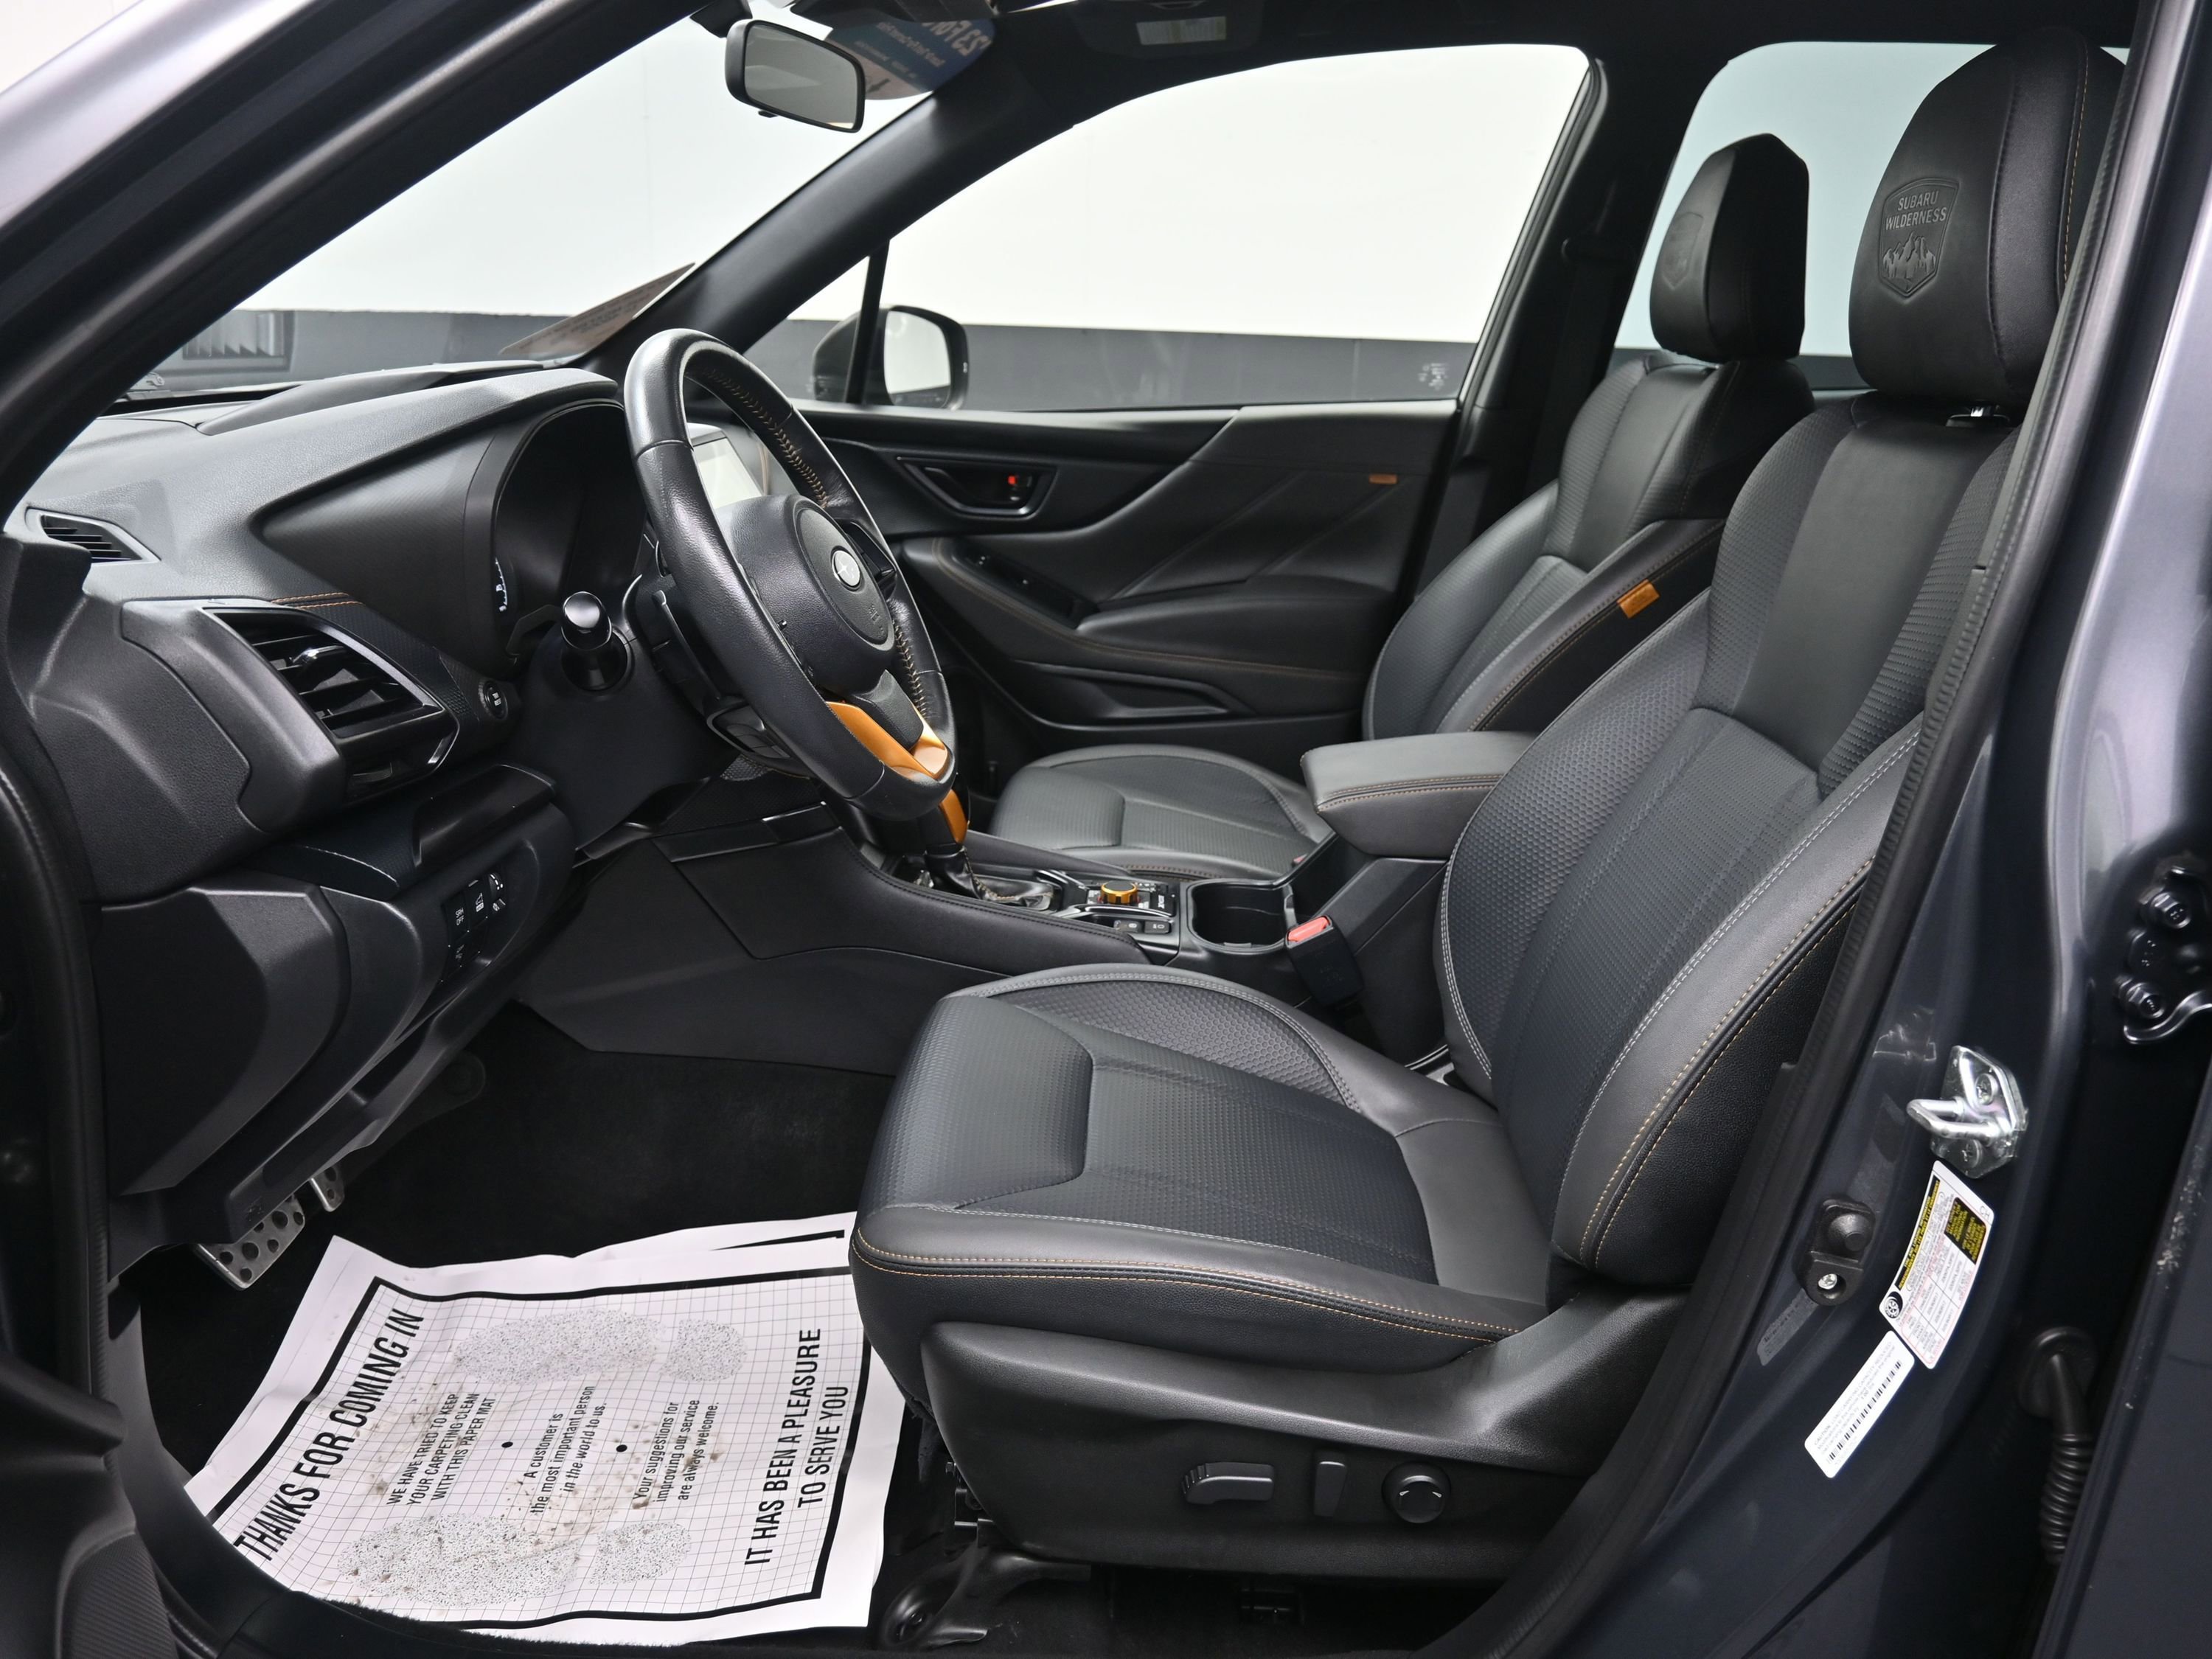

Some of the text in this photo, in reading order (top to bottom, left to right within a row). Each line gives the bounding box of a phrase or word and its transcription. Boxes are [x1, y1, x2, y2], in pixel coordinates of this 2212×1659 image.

[1885, 206, 1947, 230] WILDERNESS
[1898, 190, 1939, 211] SUBARU
[233, 1308, 424, 1561] THANKS FOR COMING IN
[386, 1394, 459, 1505] WE HAVE TRIED TO KEEP
[406, 1394, 480, 1505] YOUR CARPETING CLEAN
[431, 1398, 496, 1501] WITH THIS PAPER MAT
[524, 1413, 563, 1478] A customer is
[529, 1385, 596, 1513] the most important person
[560, 1402, 607, 1492] in the world to us.
[633, 1402, 679, 1500] Your suggestions for
[653, 1399, 700, 1502] improving our service
[678, 1402, 720, 1500] are always welcome.
[744, 1328, 821, 1565] IT HAS BEEN A PLEASURE
[797, 1386, 849, 1509] TO SERVE YOU
